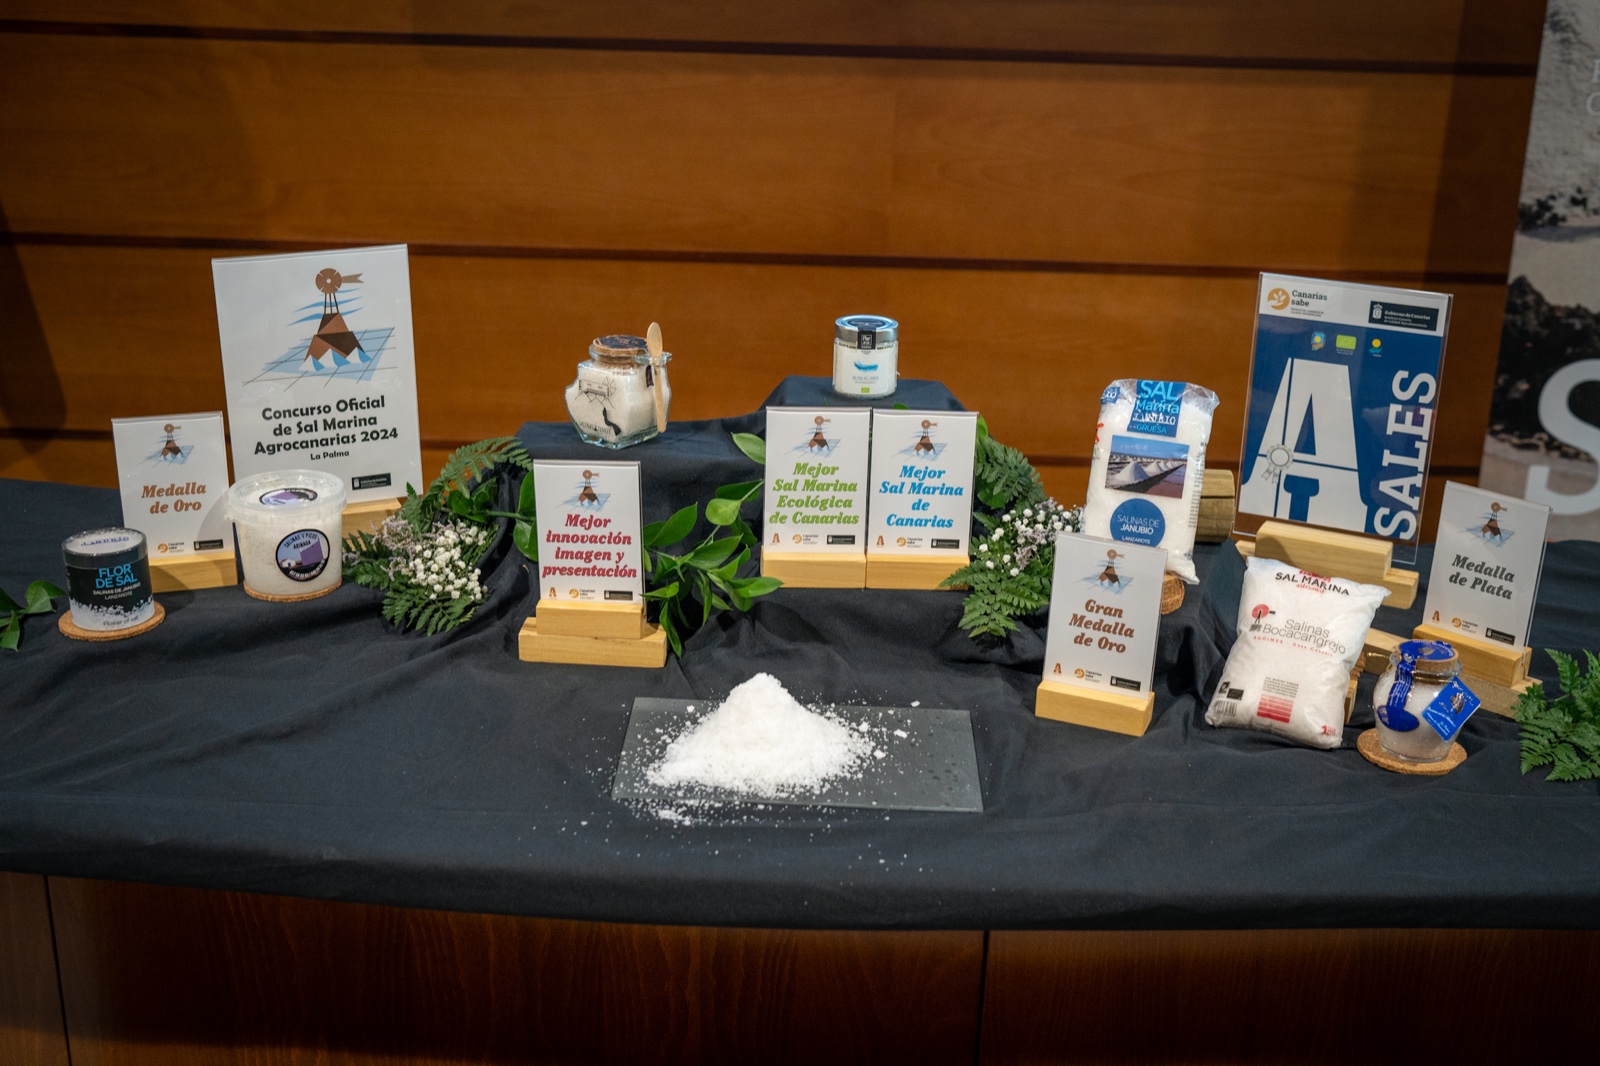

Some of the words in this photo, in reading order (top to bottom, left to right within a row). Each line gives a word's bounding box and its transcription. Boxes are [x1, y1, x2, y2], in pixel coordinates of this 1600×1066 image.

[1291, 289, 1328, 301] Canarias
[1290, 299, 1310, 307] sabe
[1384, 310, 1405, 318] Gobierno
[1411, 313, 1431, 321] Canarias
[1140, 379, 1178, 401] SAL
[262, 404, 332, 420] Concurso
[336, 395, 385, 412] Oficial
[1135, 399, 1180, 414] Marina
[273, 423, 292, 436] de
[297, 420, 318, 434] Sal
[323, 416, 377, 431] Marina
[1136, 424, 1168, 434] GRUESA
[254, 433, 357, 455] Agrocanarias
[361, 427, 398, 442] 2024
[323, 450, 350, 459] Palma
[1374, 369, 1437, 541] SALES
[793, 462, 839, 478] Mejor
[899, 465, 946, 481] Mejor
[141, 482, 206, 498] Medalla
[773, 479, 798, 492] Sal
[802, 480, 858, 492] Marina
[879, 481, 905, 494] Sal
[907, 483, 964, 496] Marina
[150, 501, 169, 514] de
[173, 499, 202, 512] Oro
[777, 495, 853, 511] Ecológica
[911, 498, 930, 511] de
[565, 514, 611, 531] Mejor
[769, 511, 788, 524] de
[792, 511, 859, 525] Canarias
[886, 513, 954, 528] Canarias
[1117, 514, 1148, 526] SALINAS
[1148, 519, 1160, 528] DE
[1120, 524, 1154, 535] JANUBIO
[546, 530, 632, 545] innovación
[1121, 535, 1151, 545] LANZAROTE
[555, 547, 612, 563] imagen
[615, 551, 624, 564] y
[99, 563, 131, 578] FLOR
[542, 564, 637, 578] presentación
[1452, 554, 1515, 582] Medalla
[95, 577, 113, 589] DE
[115, 573, 138, 586] SAL
[122, 582, 141, 592] JANUBIO
[1275, 571, 1298, 583] SAL
[1301, 575, 1350, 596] MARINA
[1449, 572, 1468, 586] de
[1470, 577, 1513, 600] Plata
[104, 591, 133, 600] LANZAROTE
[1085, 599, 1124, 618] Gran
[1068, 613, 1135, 638] Medalla
[1284, 619, 1330, 638] Salinas
[1073, 632, 1093, 646] de
[1097, 636, 1127, 653] Oro
[1262, 623, 1346, 654] Bocacangrejo
